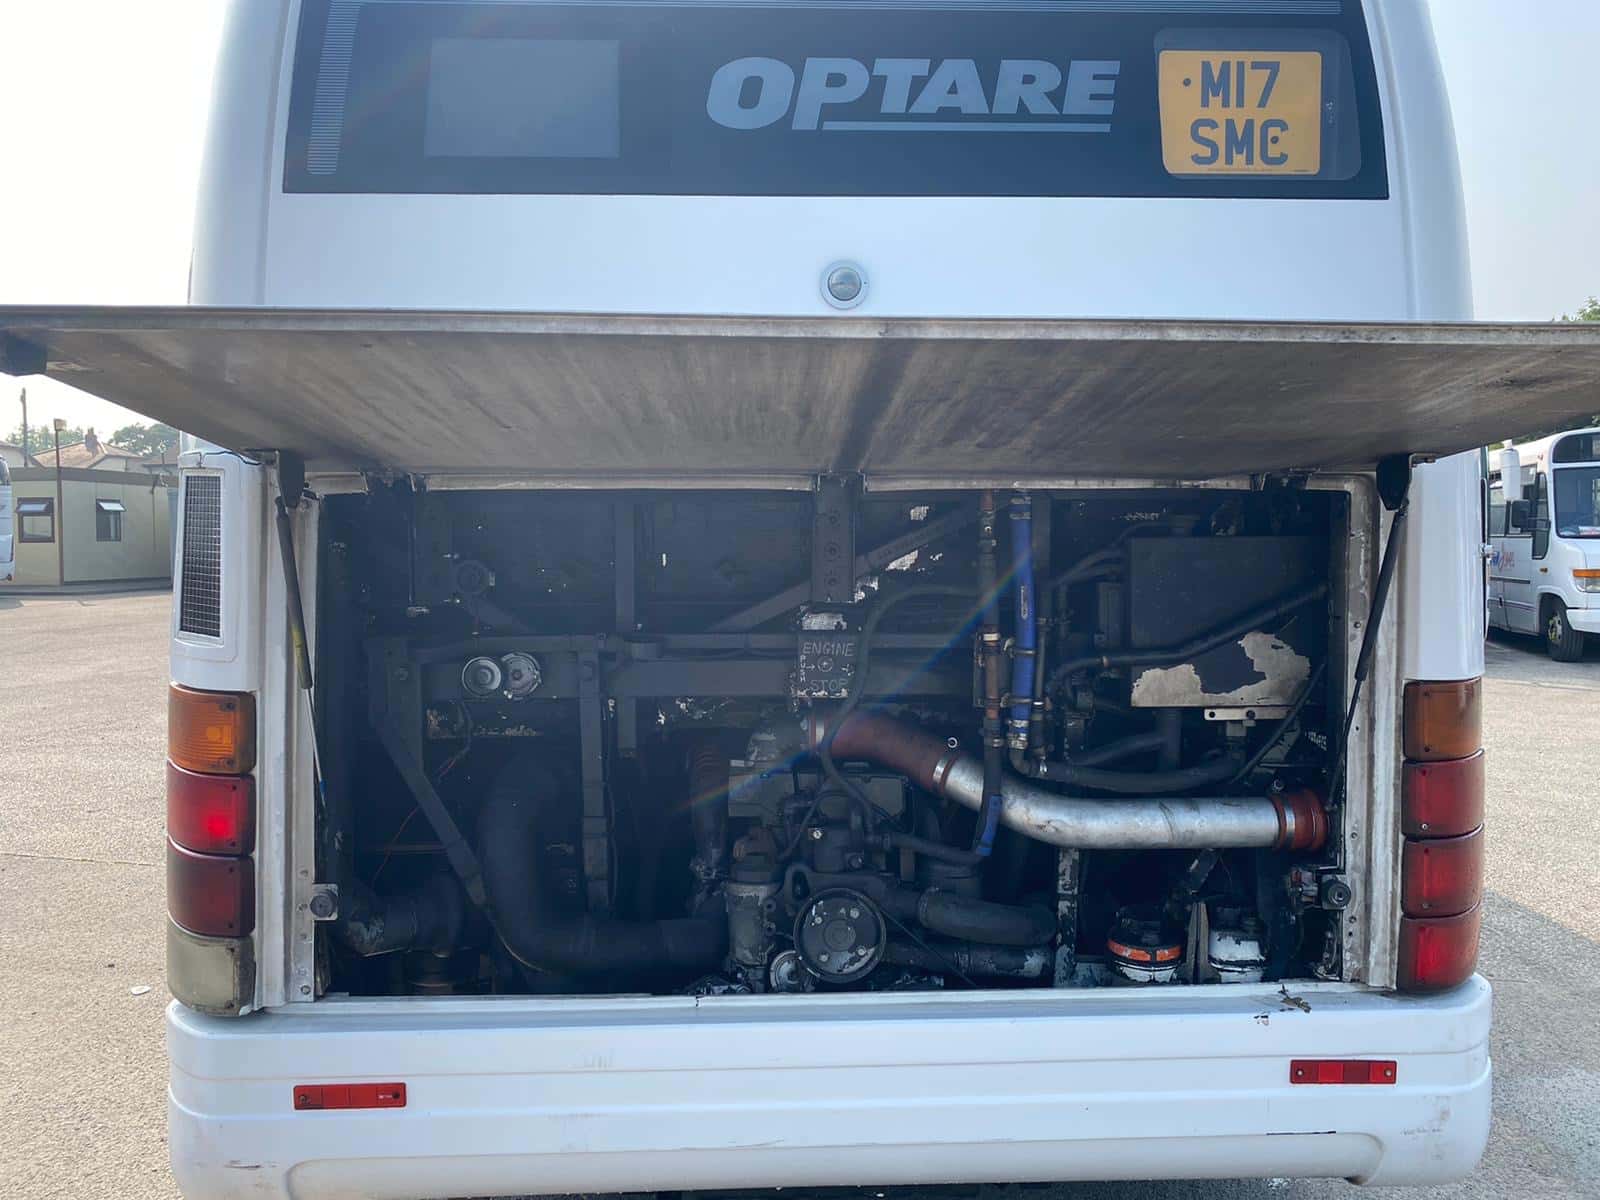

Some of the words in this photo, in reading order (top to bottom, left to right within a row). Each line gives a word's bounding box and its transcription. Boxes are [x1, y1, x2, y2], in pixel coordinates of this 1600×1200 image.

[706, 56, 1121, 131] OPTARE
[1200, 60, 1281, 109] M17
[1190, 118, 1290, 167] SMC
[802, 641, 855, 656] ENGINE
[809, 678, 849, 692] STOP
